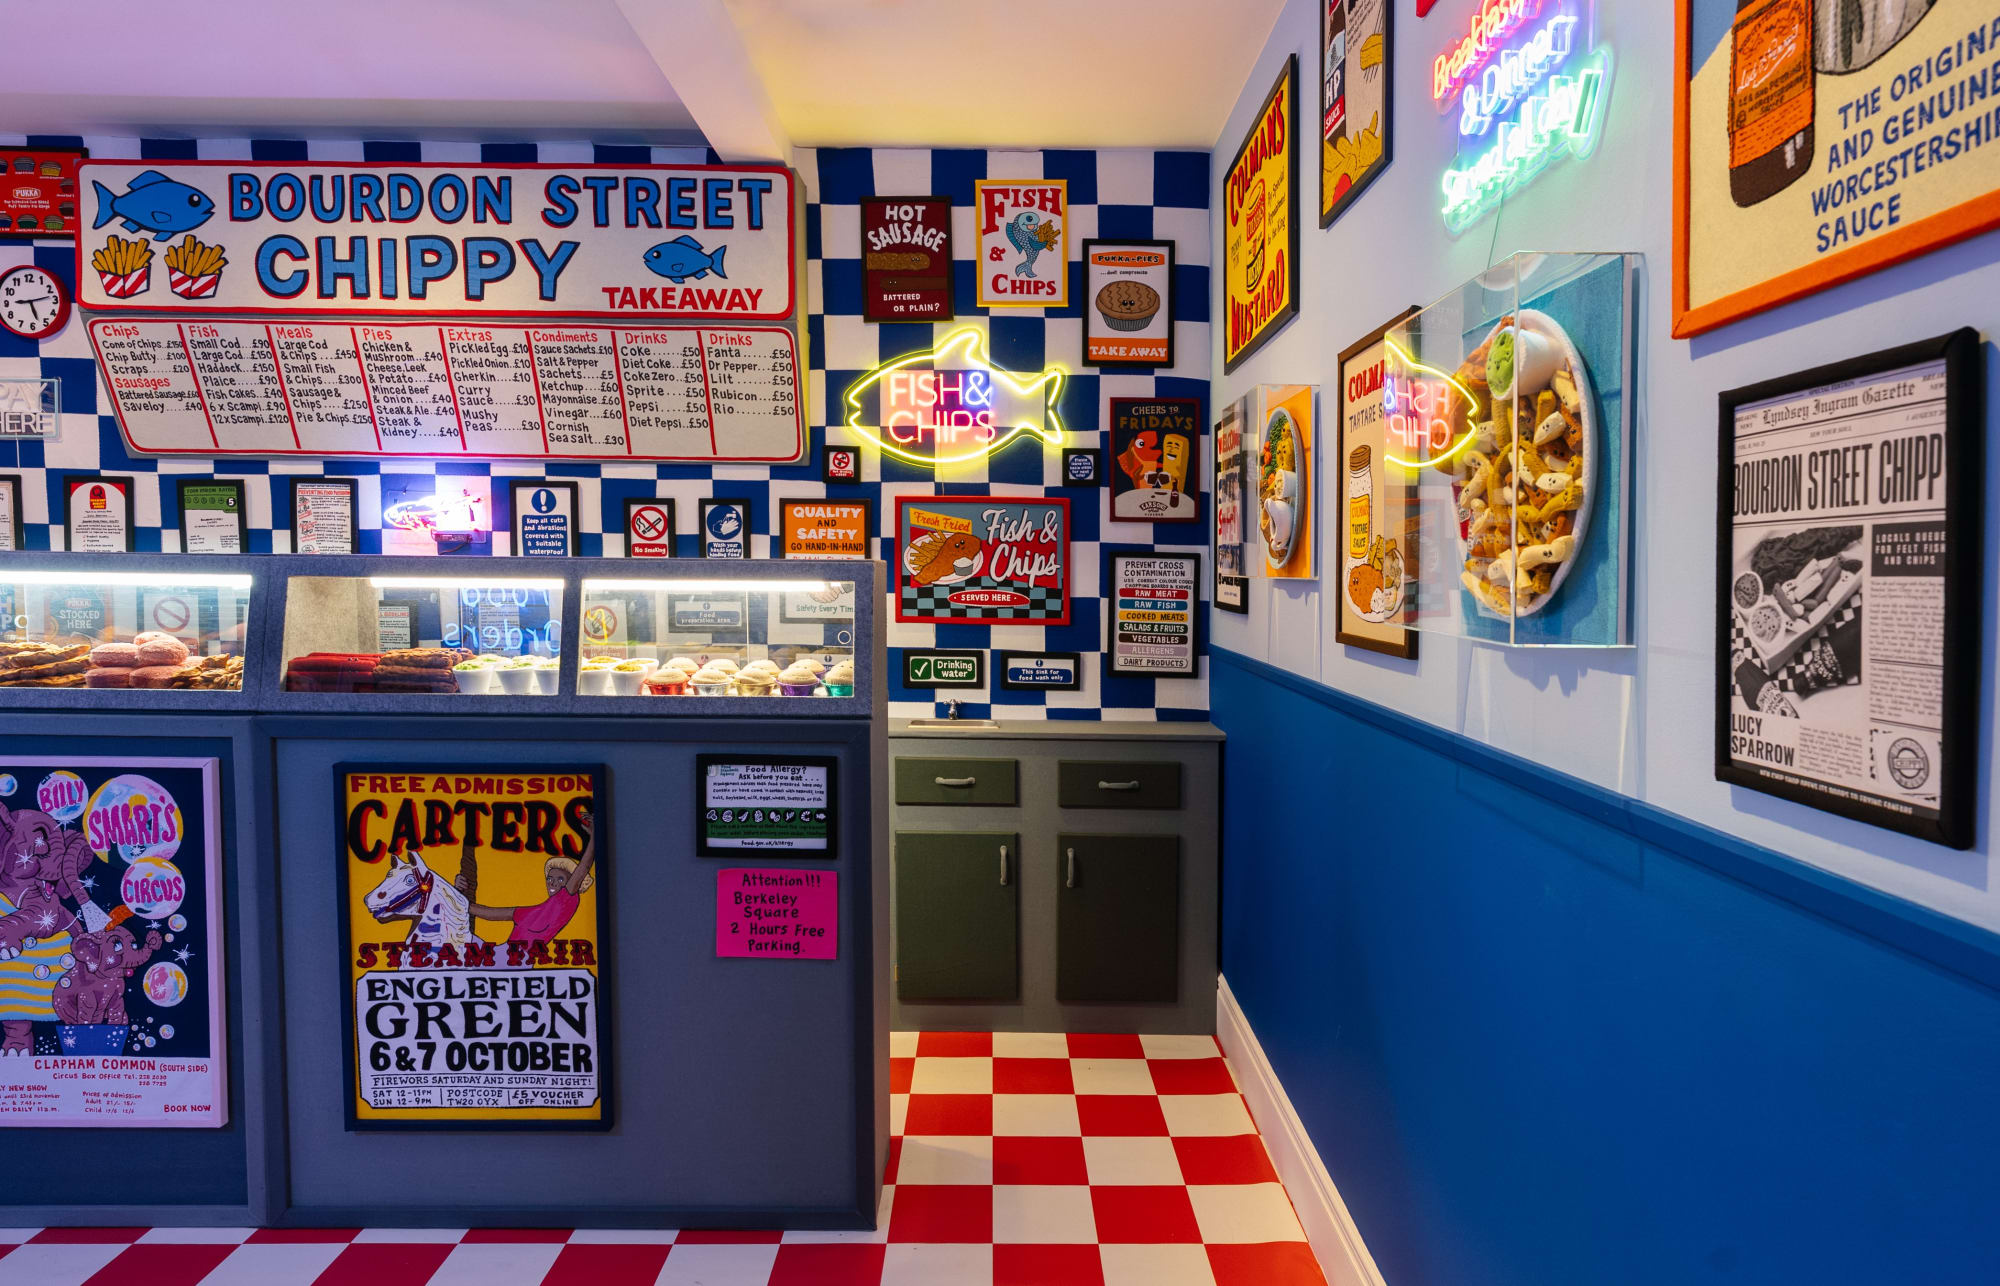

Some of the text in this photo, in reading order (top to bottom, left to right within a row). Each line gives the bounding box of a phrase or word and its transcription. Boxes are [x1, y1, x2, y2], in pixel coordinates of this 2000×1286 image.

[1326, 69, 1340, 109] HP
[1460, 84, 1492, 135] &
[1838, 86, 1880, 130] THE
[1325, 104, 1340, 129] SAUCE
[1828, 128, 1873, 173] AND
[228, 172, 773, 230] BOURDON STREET
[885, 205, 926, 221] HOT
[981, 188, 1062, 235] FISH
[1817, 193, 1900, 252] SAUCE
[868, 222, 946, 252] SAUSAGE
[989, 246, 1005, 261] &
[255, 234, 581, 302] CHIPPY
[992, 274, 1057, 296] CHIPS
[601, 286, 763, 311] TAKEAWAY
[1231, 248, 1284, 355] MUSTARD
[910, 303, 940, 312] PLAIN?
[103, 326, 139, 338] Chips
[189, 325, 218, 338] Fish
[276, 327, 313, 338] Meals
[362, 328, 392, 340] Pies
[448, 329, 492, 341] Extras
[533, 331, 598, 342] Condiments
[190, 338, 240, 349] Small Cod
[625, 332, 667, 344] Drinks
[710, 333, 752, 346] Drinks
[363, 342, 403, 351] Chicken
[707, 347, 740, 358] Fanta
[1089, 346, 1167, 357] TAKE AWAY
[106, 352, 156, 363] Chip Butty
[194, 351, 242, 362] Large Cod
[200, 364, 242, 373] Haddock
[708, 361, 758, 373] Dr Pepper
[203, 377, 236, 386] Plaice
[711, 374, 733, 384] Lilt
[541, 382, 583, 393] Ketchup
[543, 394, 597, 405] Mayonnaise
[712, 388, 757, 401] Rubicon
[1812, 393, 1858, 416] Ingram
[1862, 382, 1915, 406] Gazette
[545, 408, 589, 420] Vinegar
[714, 403, 734, 414] Rio
[1132, 405, 1166, 416] CHEERS
[463, 410, 498, 422] Mushy
[1349, 405, 1376, 432] TARTARE
[889, 411, 995, 443] CHIPS
[1120, 416, 1193, 430] FRIDAYS
[1734, 453, 1802, 516] BOURDON
[1808, 443, 1872, 510] STREET
[793, 507, 862, 518] QUALITY
[914, 512, 971, 532] Fresh Fried
[982, 508, 1058, 545] Fish &
[797, 528, 857, 540] SAFETY
[1876, 533, 1910, 543] LOCALS
[791, 543, 863, 551] GO HAND-IN-HAND
[1875, 545, 1891, 554] FOR
[1896, 544, 1918, 553] FELT
[990, 543, 1060, 588] Chips
[1126, 561, 1184, 570] PREVENT CROSS
[1884, 555, 1935, 565] AND CHIPS
[60, 610, 99, 619] STOCKED
[819, 604, 837, 613] Every
[67, 620, 92, 629] HERE
[1124, 623, 1151, 631] SALADS
[1132, 635, 1179, 643] VEGETABLES
[1132, 647, 1174, 655] ALLERGENS
[937, 661, 972, 672] Drinking
[1147, 659, 1183, 667] PRODUCTS
[941, 670, 967, 678] water
[1732, 713, 1762, 734] LUCY
[1732, 736, 1795, 767] SPARROW
[770, 766, 807, 775] Allergy?
[351, 775, 592, 795] FREE ADMISSION
[39, 780, 84, 813] BILLY
[349, 796, 594, 864] CARTERS
[123, 877, 182, 904] CIRCUS
[734, 891, 798, 906] Berkeley
[744, 906, 799, 920] Square
[730, 922, 824, 937] 2 Hours Free
[356, 939, 596, 968] STEAM FAIR
[366, 976, 591, 1001] ENGLEFIELD
[365, 1001, 588, 1039] GREEN
[446, 1042, 592, 1072] OCTOBER
[35, 1059, 208, 1073] CLAPHAM COMMON (SOUTH SIDE)
[373, 1076, 548, 1086] FIREWORS SATURDAY AND SUNDAY
[447, 1089, 584, 1099] POSTCODE £5 VOUCHER
[164, 1105, 188, 1113] BOOK
